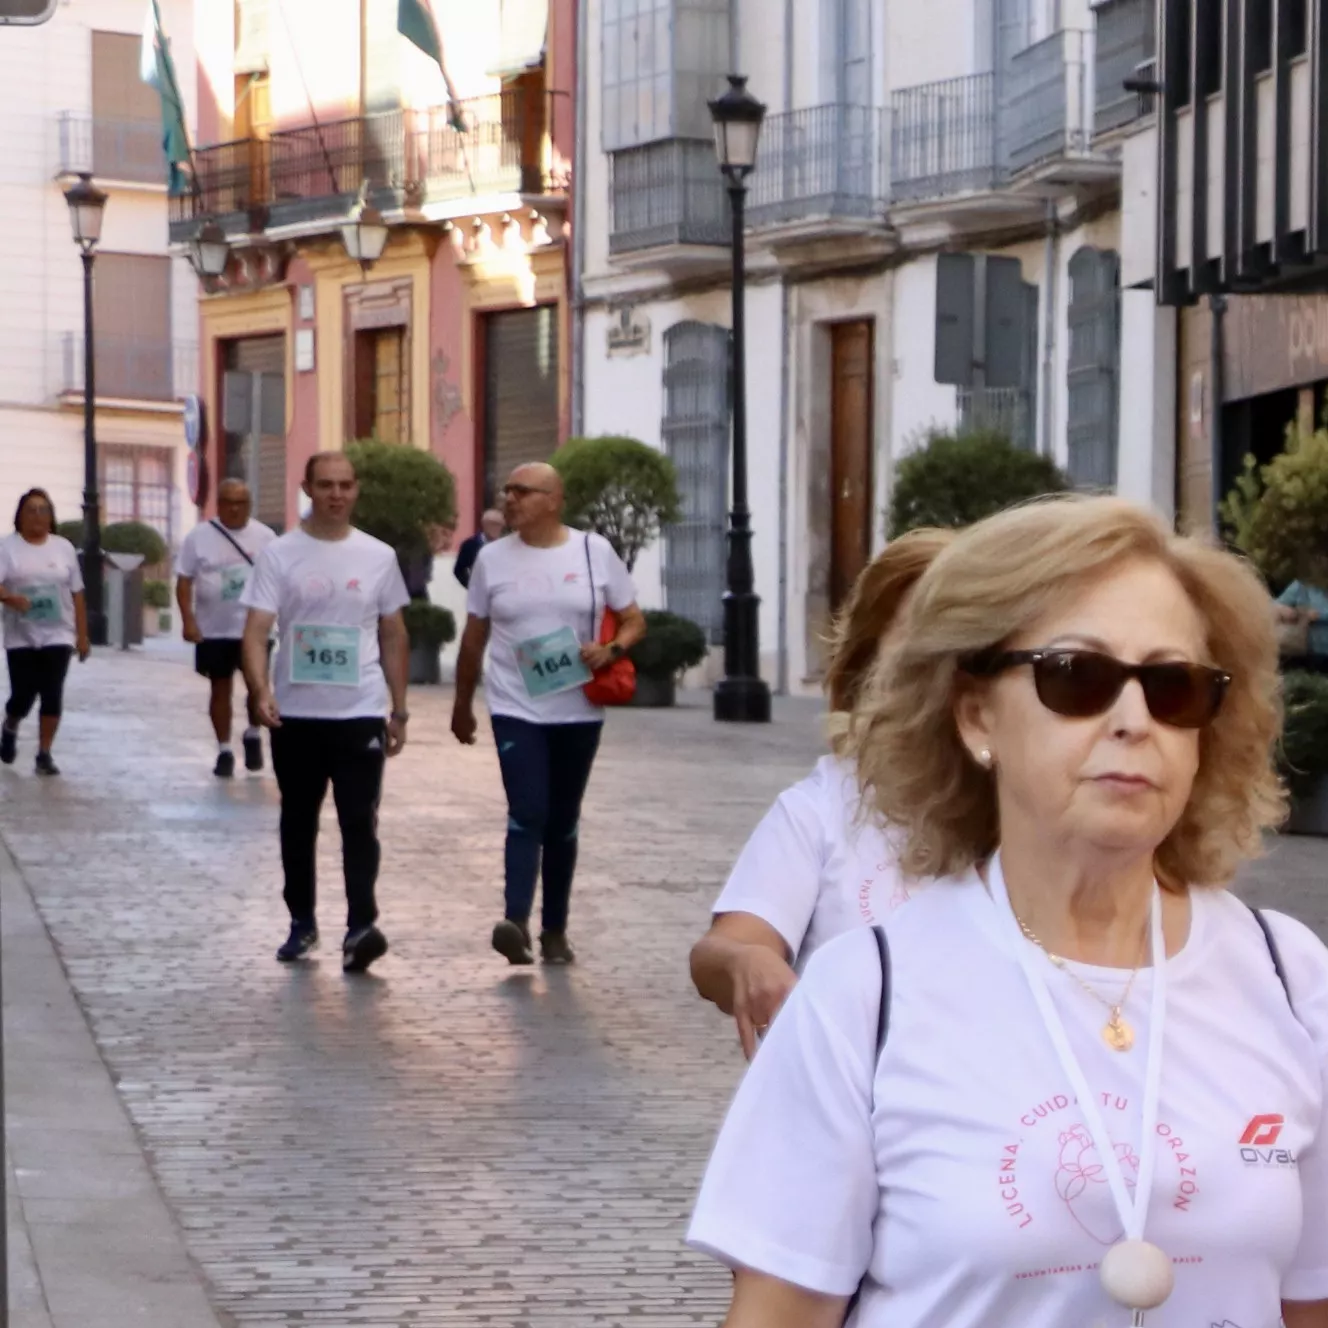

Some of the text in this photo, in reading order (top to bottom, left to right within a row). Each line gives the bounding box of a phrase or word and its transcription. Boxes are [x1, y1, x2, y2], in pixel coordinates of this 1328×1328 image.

[306, 649, 349, 666] 165
[532, 652, 573, 677] 164
[1101, 1091, 1129, 1112] TU
[1155, 1122, 1201, 1212] ORAZÓN
